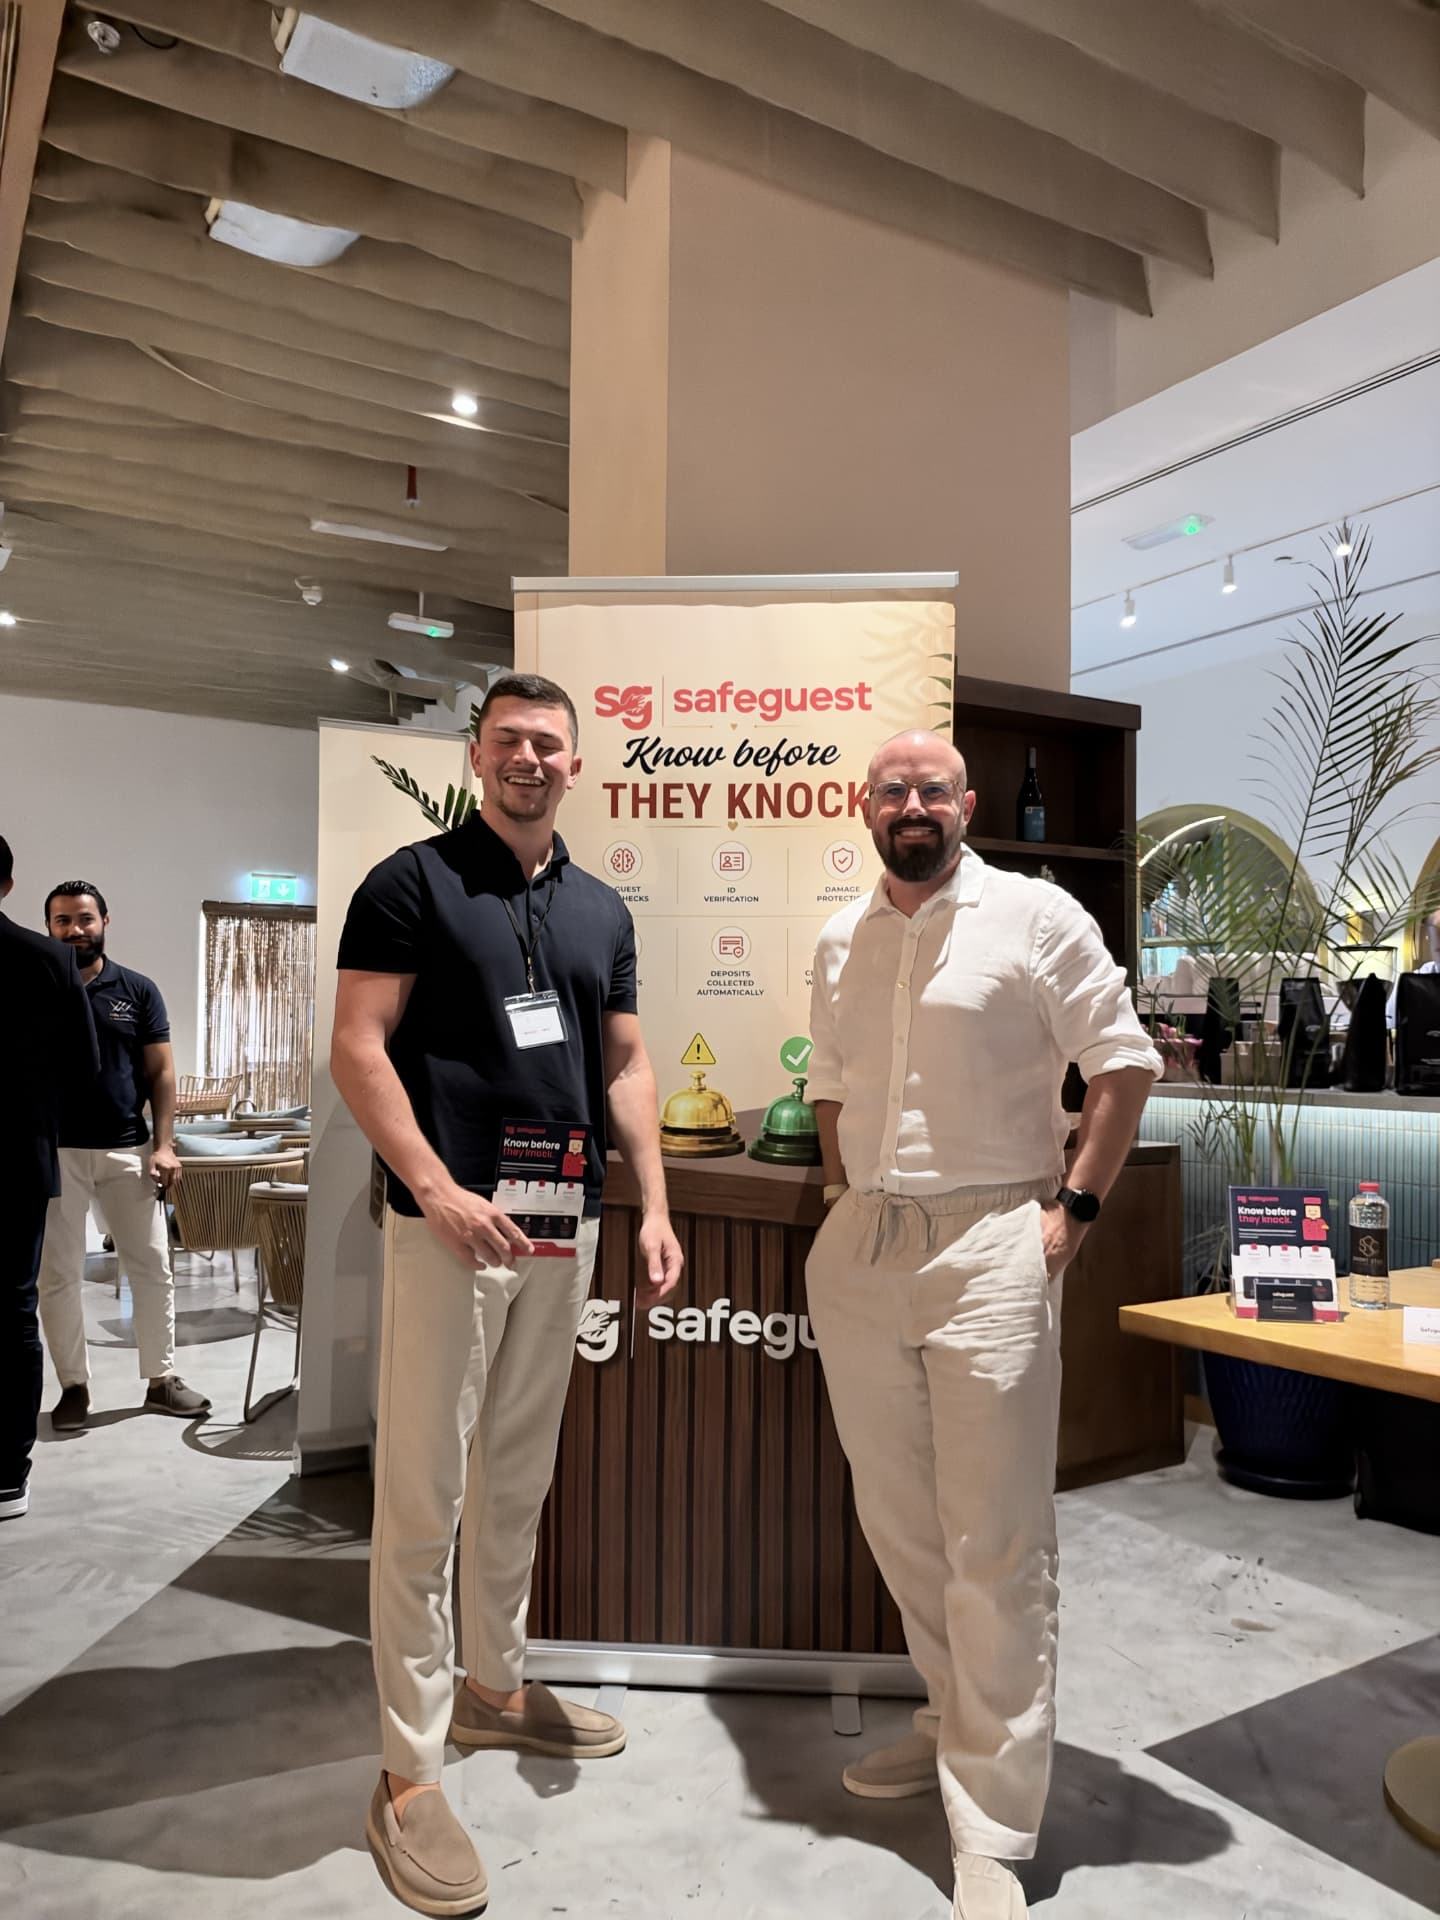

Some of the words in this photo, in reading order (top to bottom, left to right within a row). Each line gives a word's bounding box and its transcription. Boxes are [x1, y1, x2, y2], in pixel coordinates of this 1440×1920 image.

[673, 681, 872, 722] safeguest
[622, 736, 726, 775] Know
[732, 737, 841, 777] before
[602, 782, 712, 819] THEY
[727, 781, 869, 819] KNOCK
[710, 970, 751, 978] DEPOSITS
[706, 979, 754, 988] COLLECTED
[696, 988, 765, 997] AUTOMATICALLY
[503, 1137, 530, 1149] Know
[530, 1140, 561, 1151] before
[1237, 1206, 1264, 1215] Know
[1265, 1206, 1297, 1216] before
